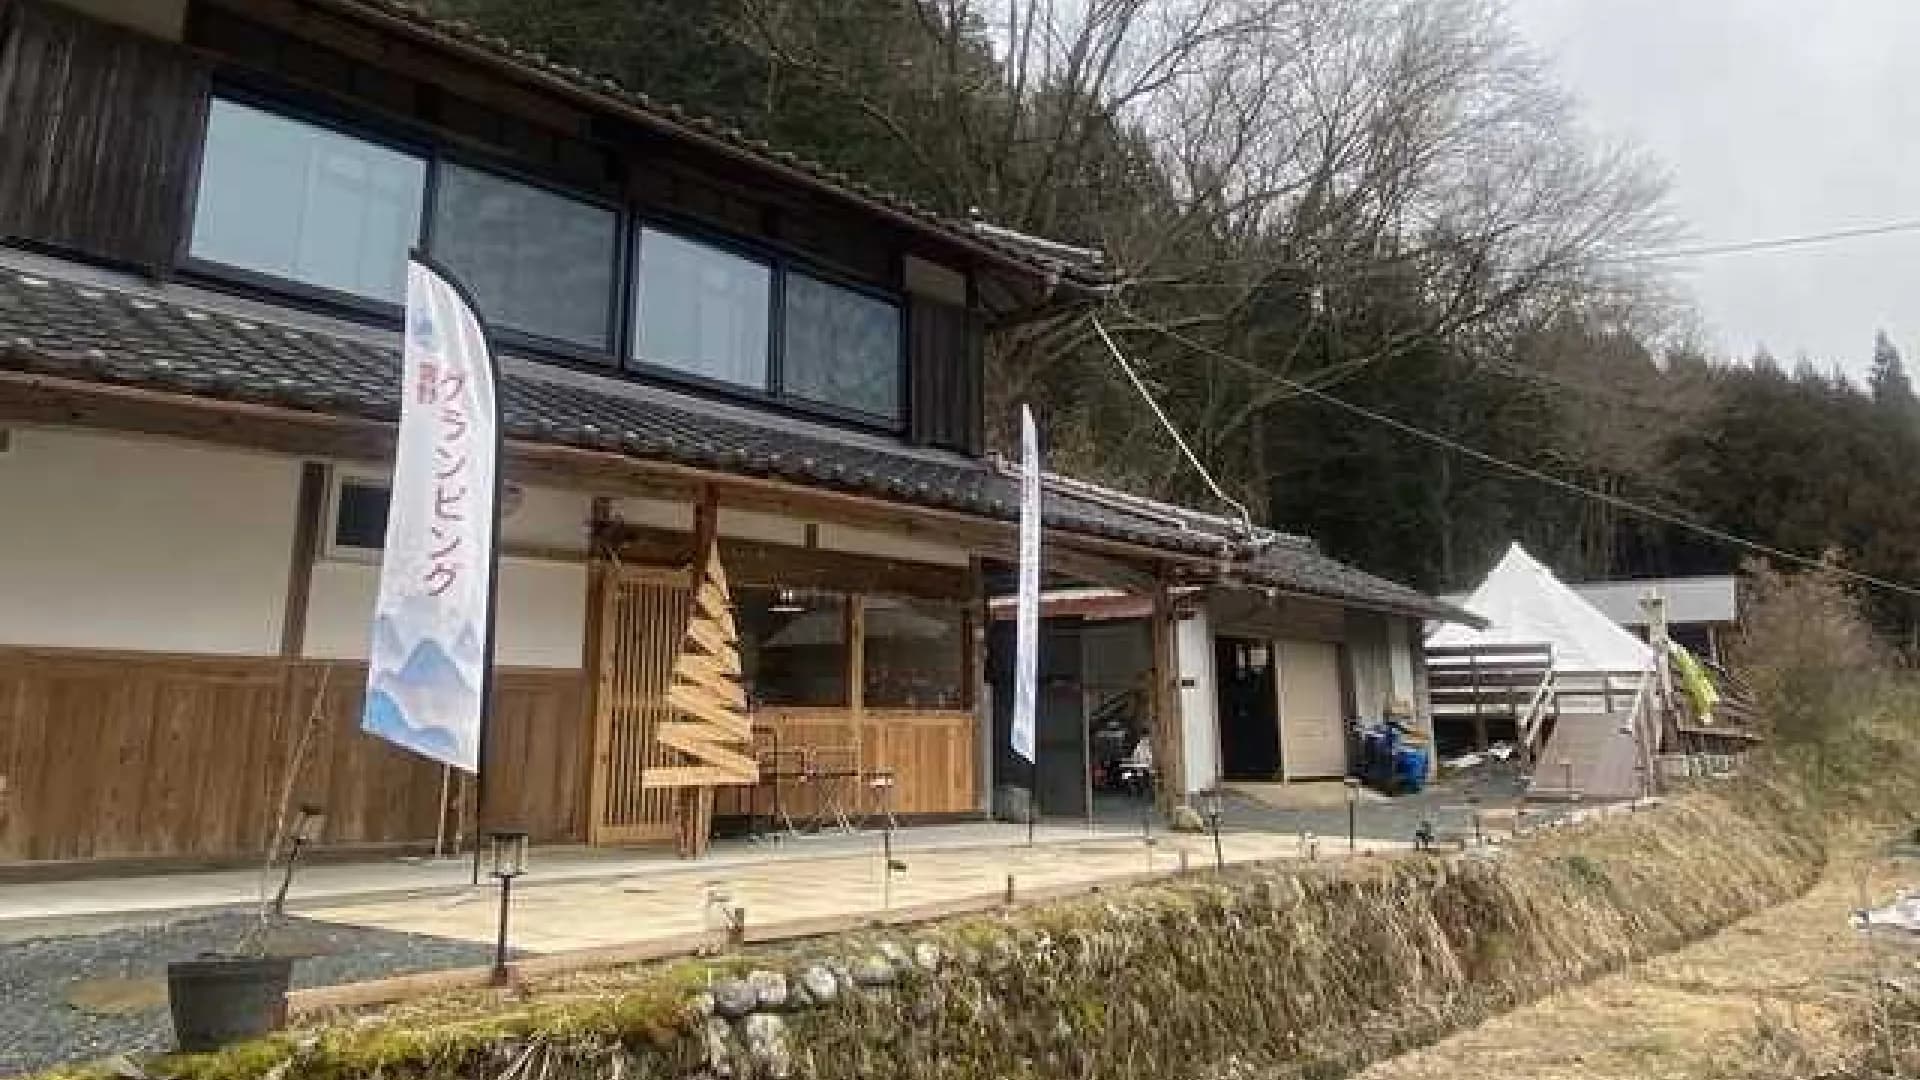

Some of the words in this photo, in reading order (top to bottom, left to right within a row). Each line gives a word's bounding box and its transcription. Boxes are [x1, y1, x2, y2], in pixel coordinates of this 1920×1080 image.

[424, 373, 466, 596] グランピング
